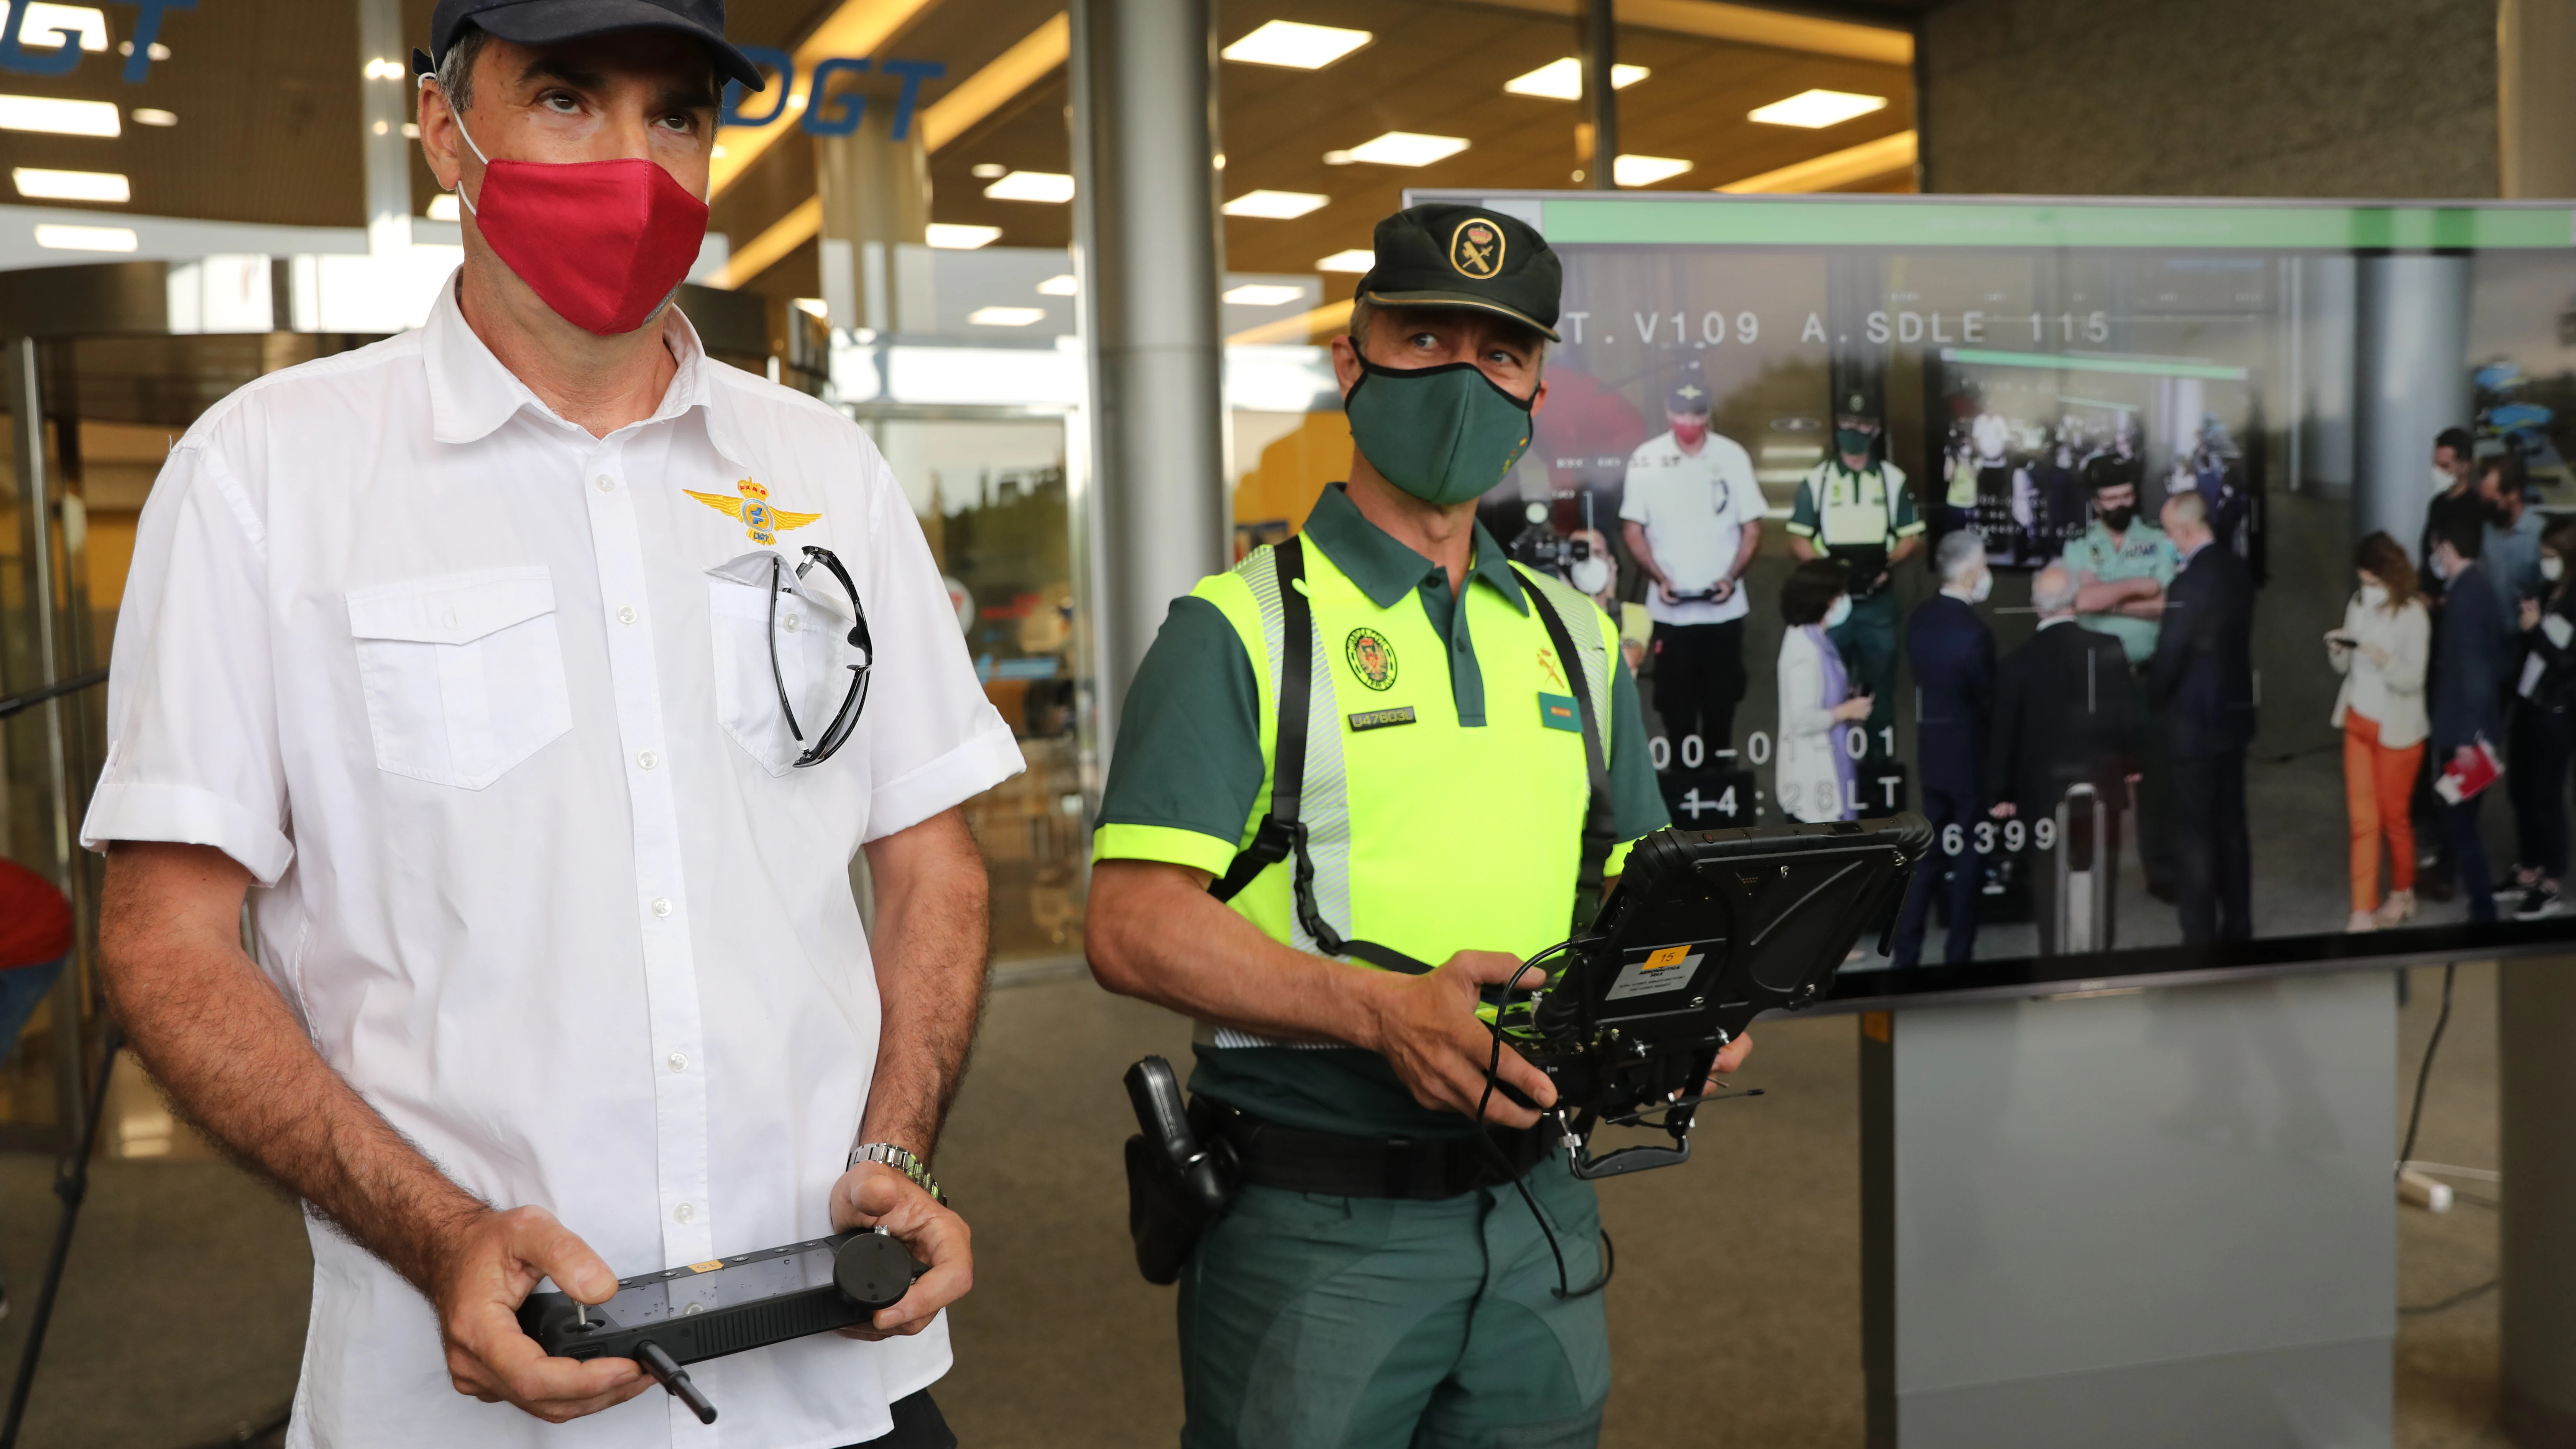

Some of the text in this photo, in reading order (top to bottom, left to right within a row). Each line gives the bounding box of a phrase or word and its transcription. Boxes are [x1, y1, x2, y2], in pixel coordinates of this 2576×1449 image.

[721, 44, 945, 142] DGT
[1797, 311, 1986, 343] A.SDLE
[2029, 310, 2110, 343] 115
[754, 532, 769, 542] DGT
[1351, 710, 1413, 728] U47603L
[1942, 817, 2057, 856] 6399
[1660, 952, 1676, 963] 15
